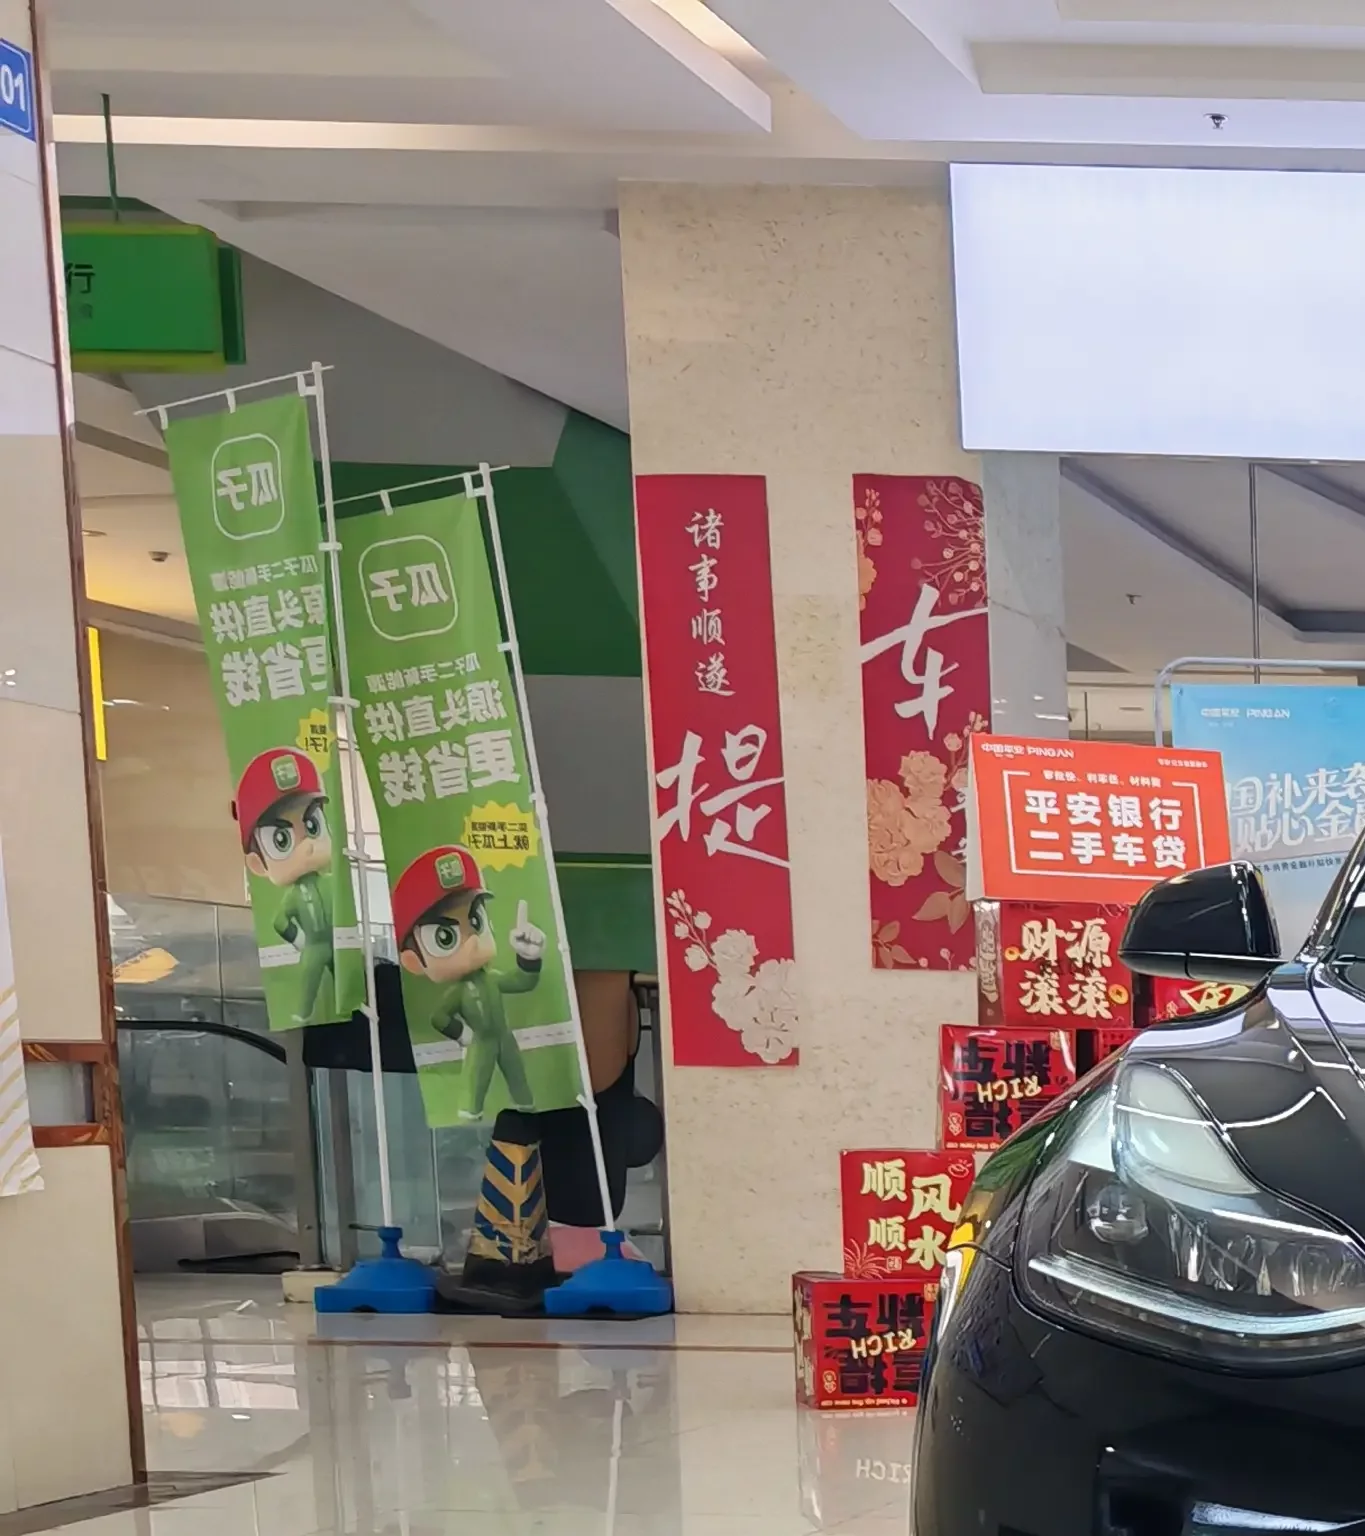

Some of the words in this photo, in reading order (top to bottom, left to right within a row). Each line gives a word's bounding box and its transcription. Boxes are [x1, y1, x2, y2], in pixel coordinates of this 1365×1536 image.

[684, 508, 735, 697] 诸事顺遂
[860, 583, 989, 740] 车
[656, 723, 790, 869] 提
[1024, 788, 1184, 832] 平安银行
[1028, 830, 1187, 870] 二手车贷
[1019, 917, 1113, 968] 财源
[1018, 968, 1114, 1020] 滚滚
[976, 1074, 1042, 1103] RICH
[861, 1158, 963, 1224] 顺风
[867, 1215, 949, 1271] 顺水
[850, 1328, 917, 1360] RICH
